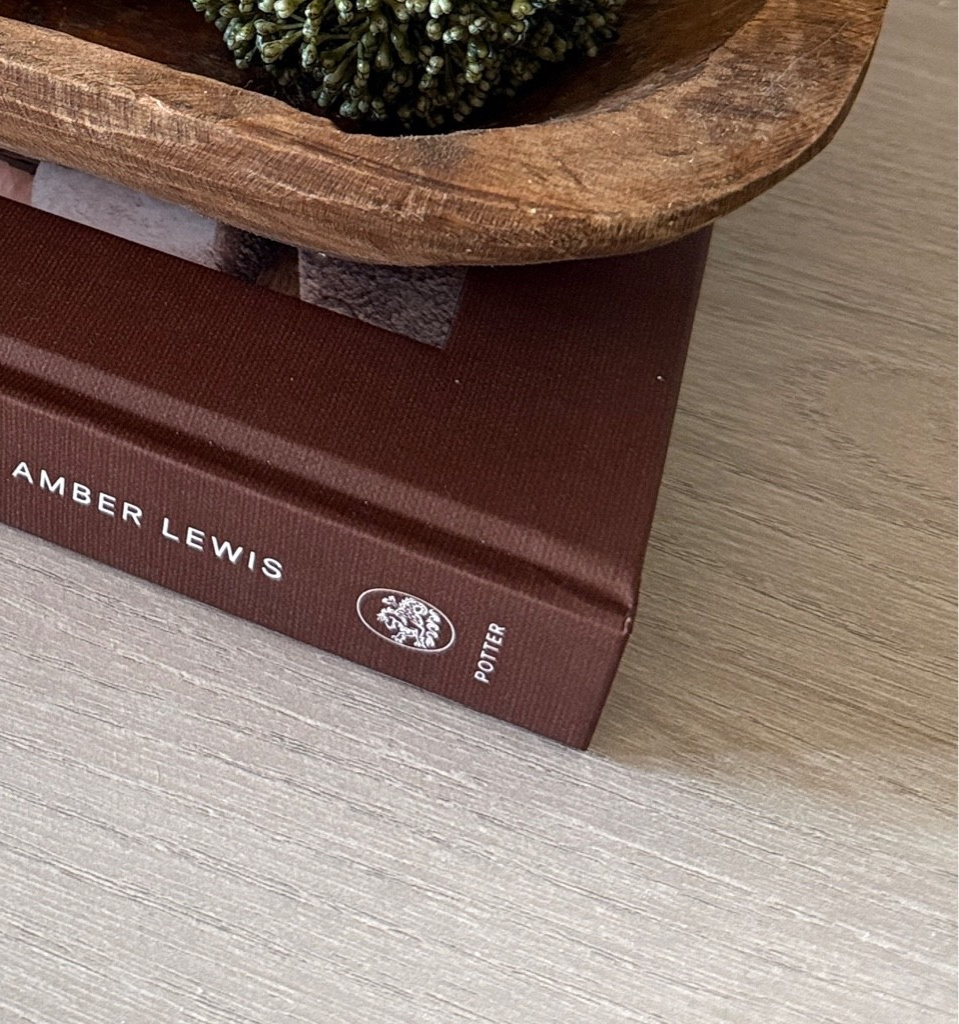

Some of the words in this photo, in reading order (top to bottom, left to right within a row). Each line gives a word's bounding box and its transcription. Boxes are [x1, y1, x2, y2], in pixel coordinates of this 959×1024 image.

[11, 460, 143, 527] AMBER
[160, 516, 283, 581] LEWIS
[473, 622, 506, 684] POTTER
